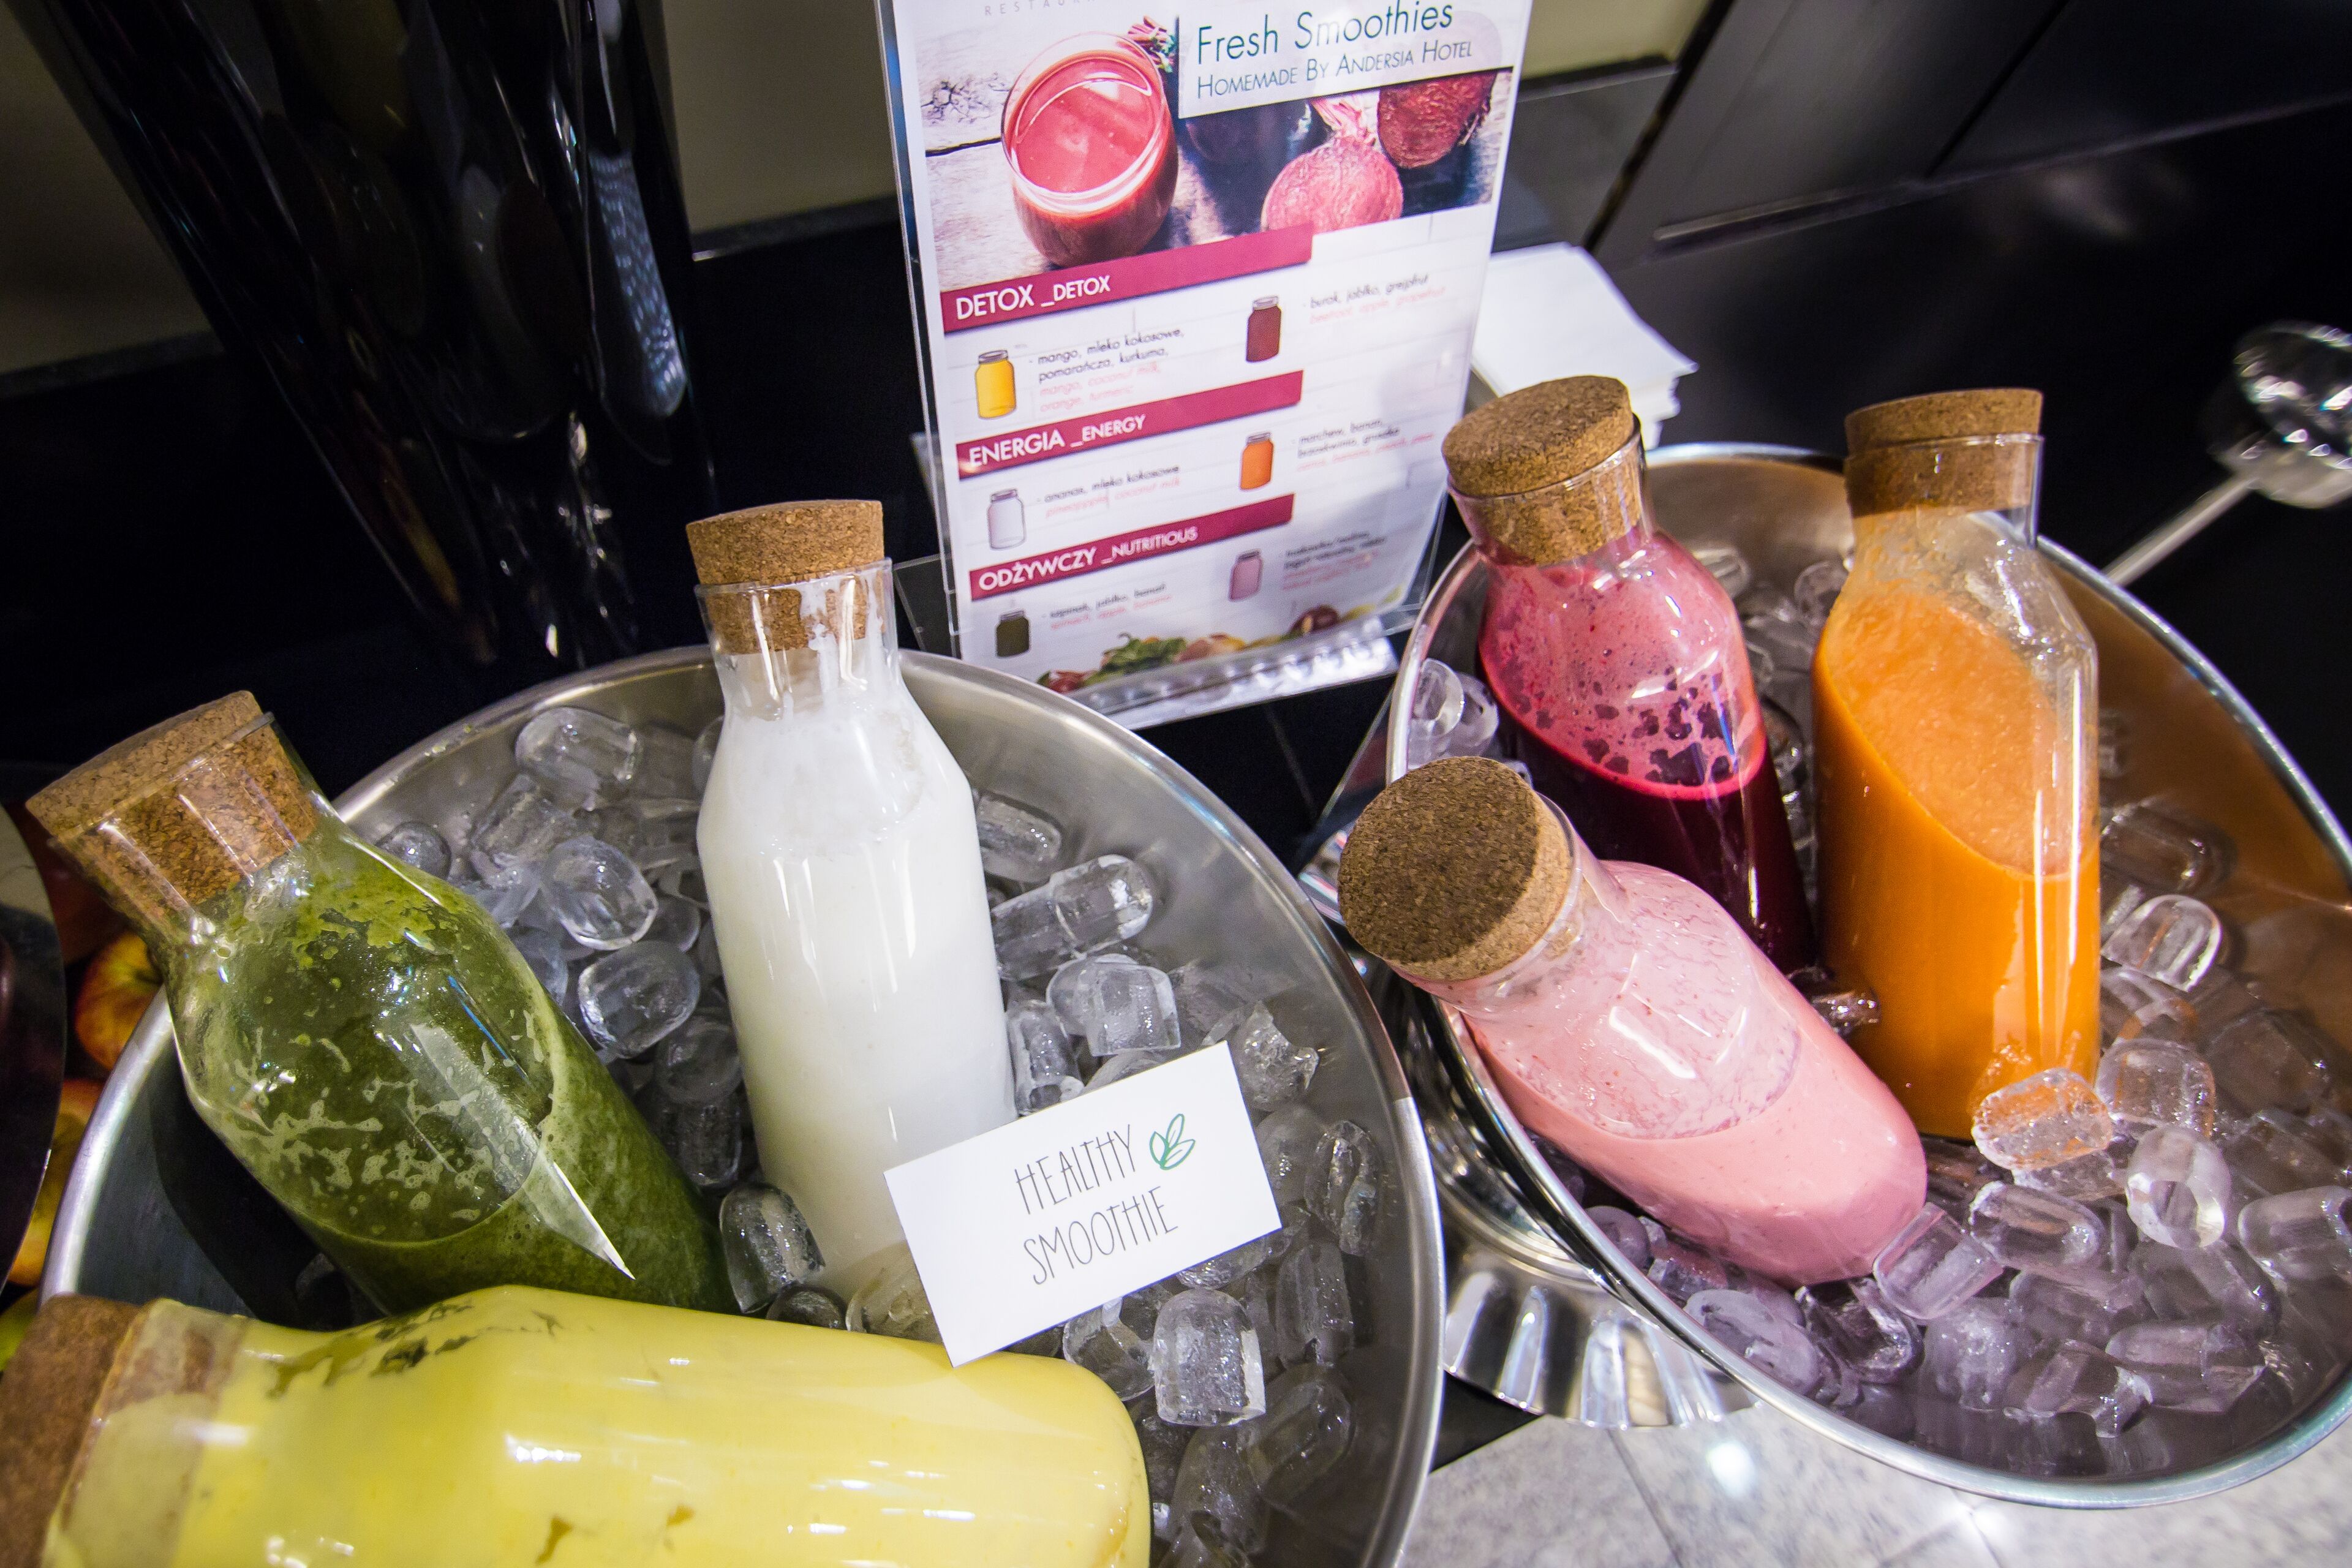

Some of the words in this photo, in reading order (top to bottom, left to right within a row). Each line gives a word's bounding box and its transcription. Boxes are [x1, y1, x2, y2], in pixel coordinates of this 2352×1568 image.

[1198, 14, 1278, 64] Fresh
[1294, 0, 1453, 50] Smoothies
[1197, 67, 1298, 99] HOMEMADE
[1306, 59, 1328, 81] BY
[1336, 50, 1414, 77] ANDERSIA
[1422, 40, 1472, 63] HOTEL
[956, 284, 1035, 320] DETOX
[1087, 339, 1120, 354] mleko
[969, 429, 1065, 466] ENERGIA
[979, 546, 1098, 591] ODŻYWCZY
[1014, 1123, 1137, 1215] HEALTHY
[1022, 1185, 1178, 1285] SMOOTHIE
